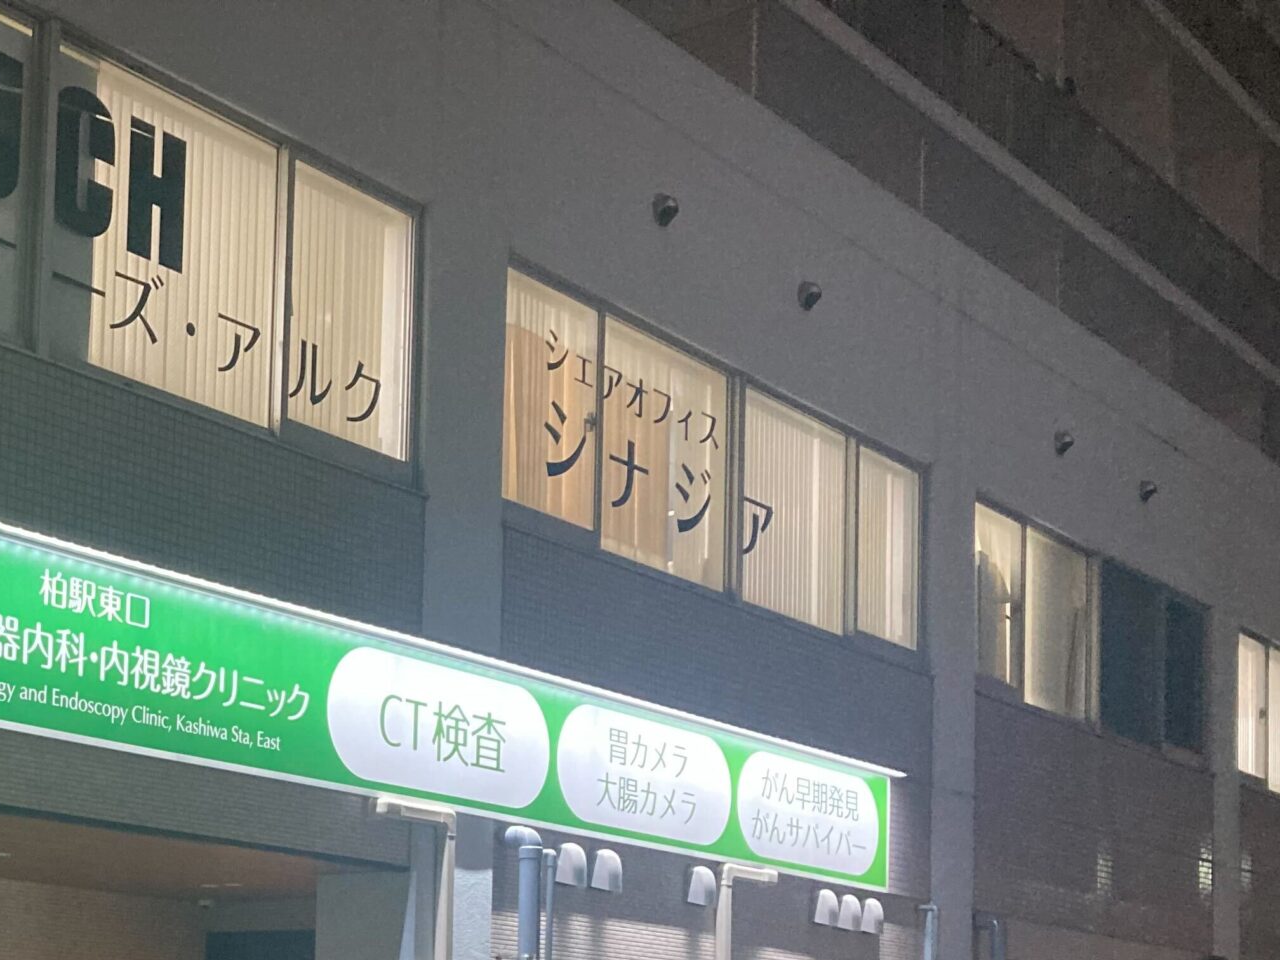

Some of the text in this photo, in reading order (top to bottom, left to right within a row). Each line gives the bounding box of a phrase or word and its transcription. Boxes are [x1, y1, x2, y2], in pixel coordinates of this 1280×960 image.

[545, 329, 720, 450] シェアオフィス
[544, 400, 774, 555] シナジア
[39, 567, 151, 629] 柏駅東口
[19, 684, 48, 705] and
[51, 687, 129, 726] Endoscopy
[131, 705, 172, 732] Clinic,
[176, 713, 228, 741] Kashiwa
[231, 725, 253, 749] Sta,
[256, 731, 281, 751] East
[378, 693, 507, 774] CT検査
[609, 727, 688, 778] 胃カメラ
[596, 772, 697, 825] 大腸カメラ
[761, 768, 859, 822] がん早期発見
[751, 808, 867, 856] がんサバイバー
